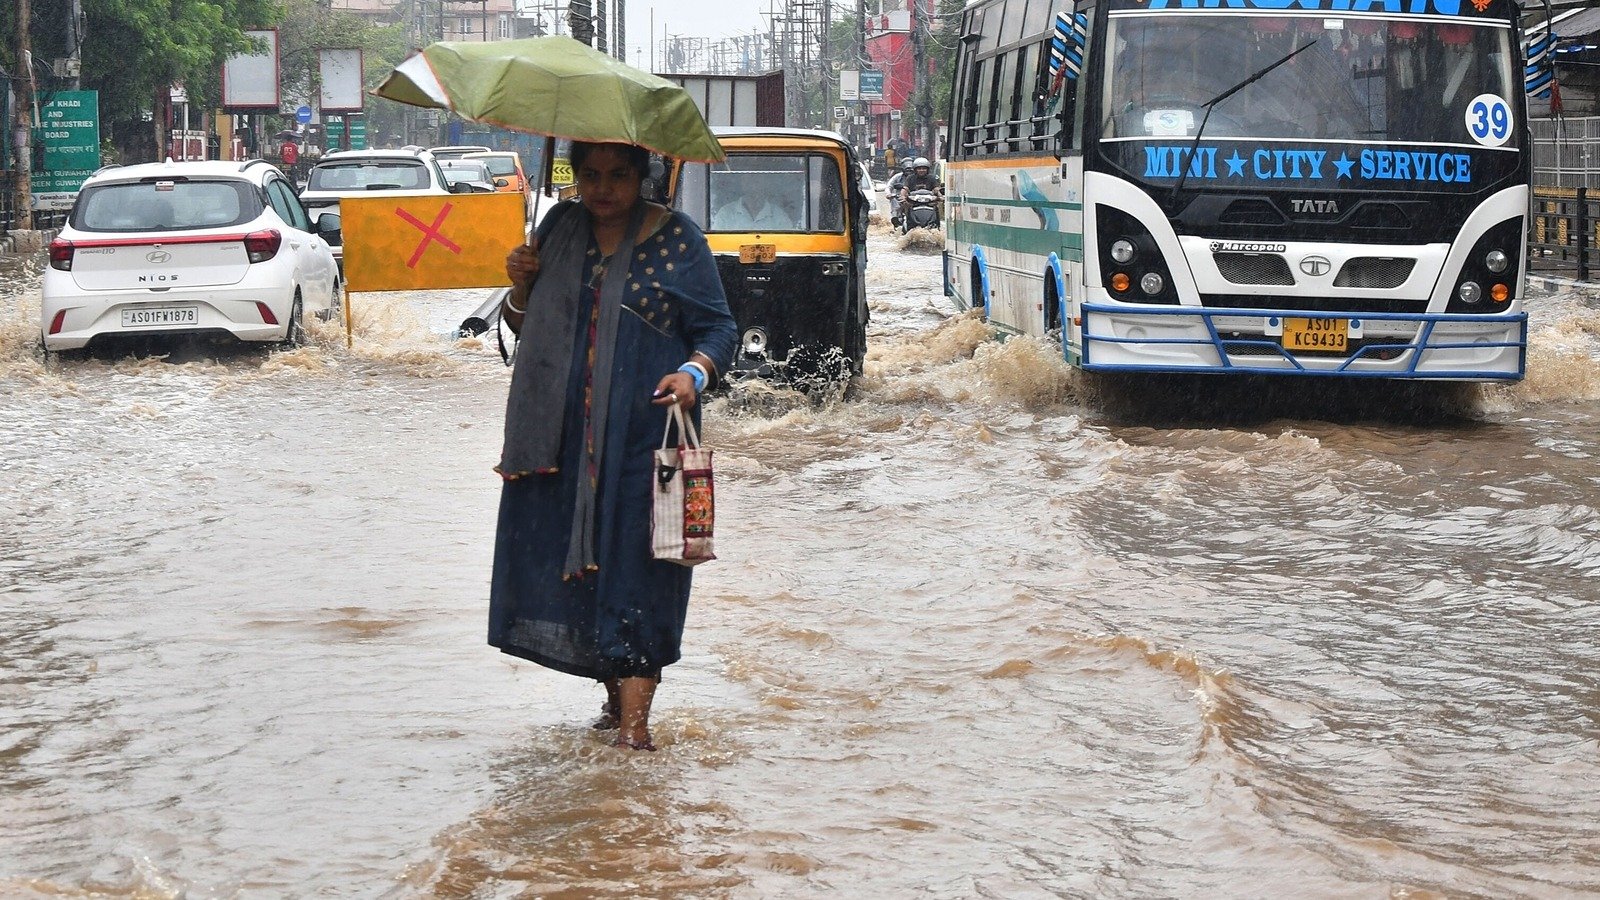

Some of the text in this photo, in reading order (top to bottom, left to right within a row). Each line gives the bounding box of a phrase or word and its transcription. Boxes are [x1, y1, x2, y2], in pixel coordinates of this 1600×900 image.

[52, 120, 94, 128] INDUSTRIES
[1472, 101, 1508, 139] 39
[1143, 146, 1470, 182] MINI CITY SERVICE
[1291, 200, 1339, 213] TATA
[1222, 242, 1286, 252] Marcopolo
[130, 311, 194, 324] AS01FW1878
[1307, 317, 1338, 331] AS01
[1295, 332, 1345, 347] KC9433
